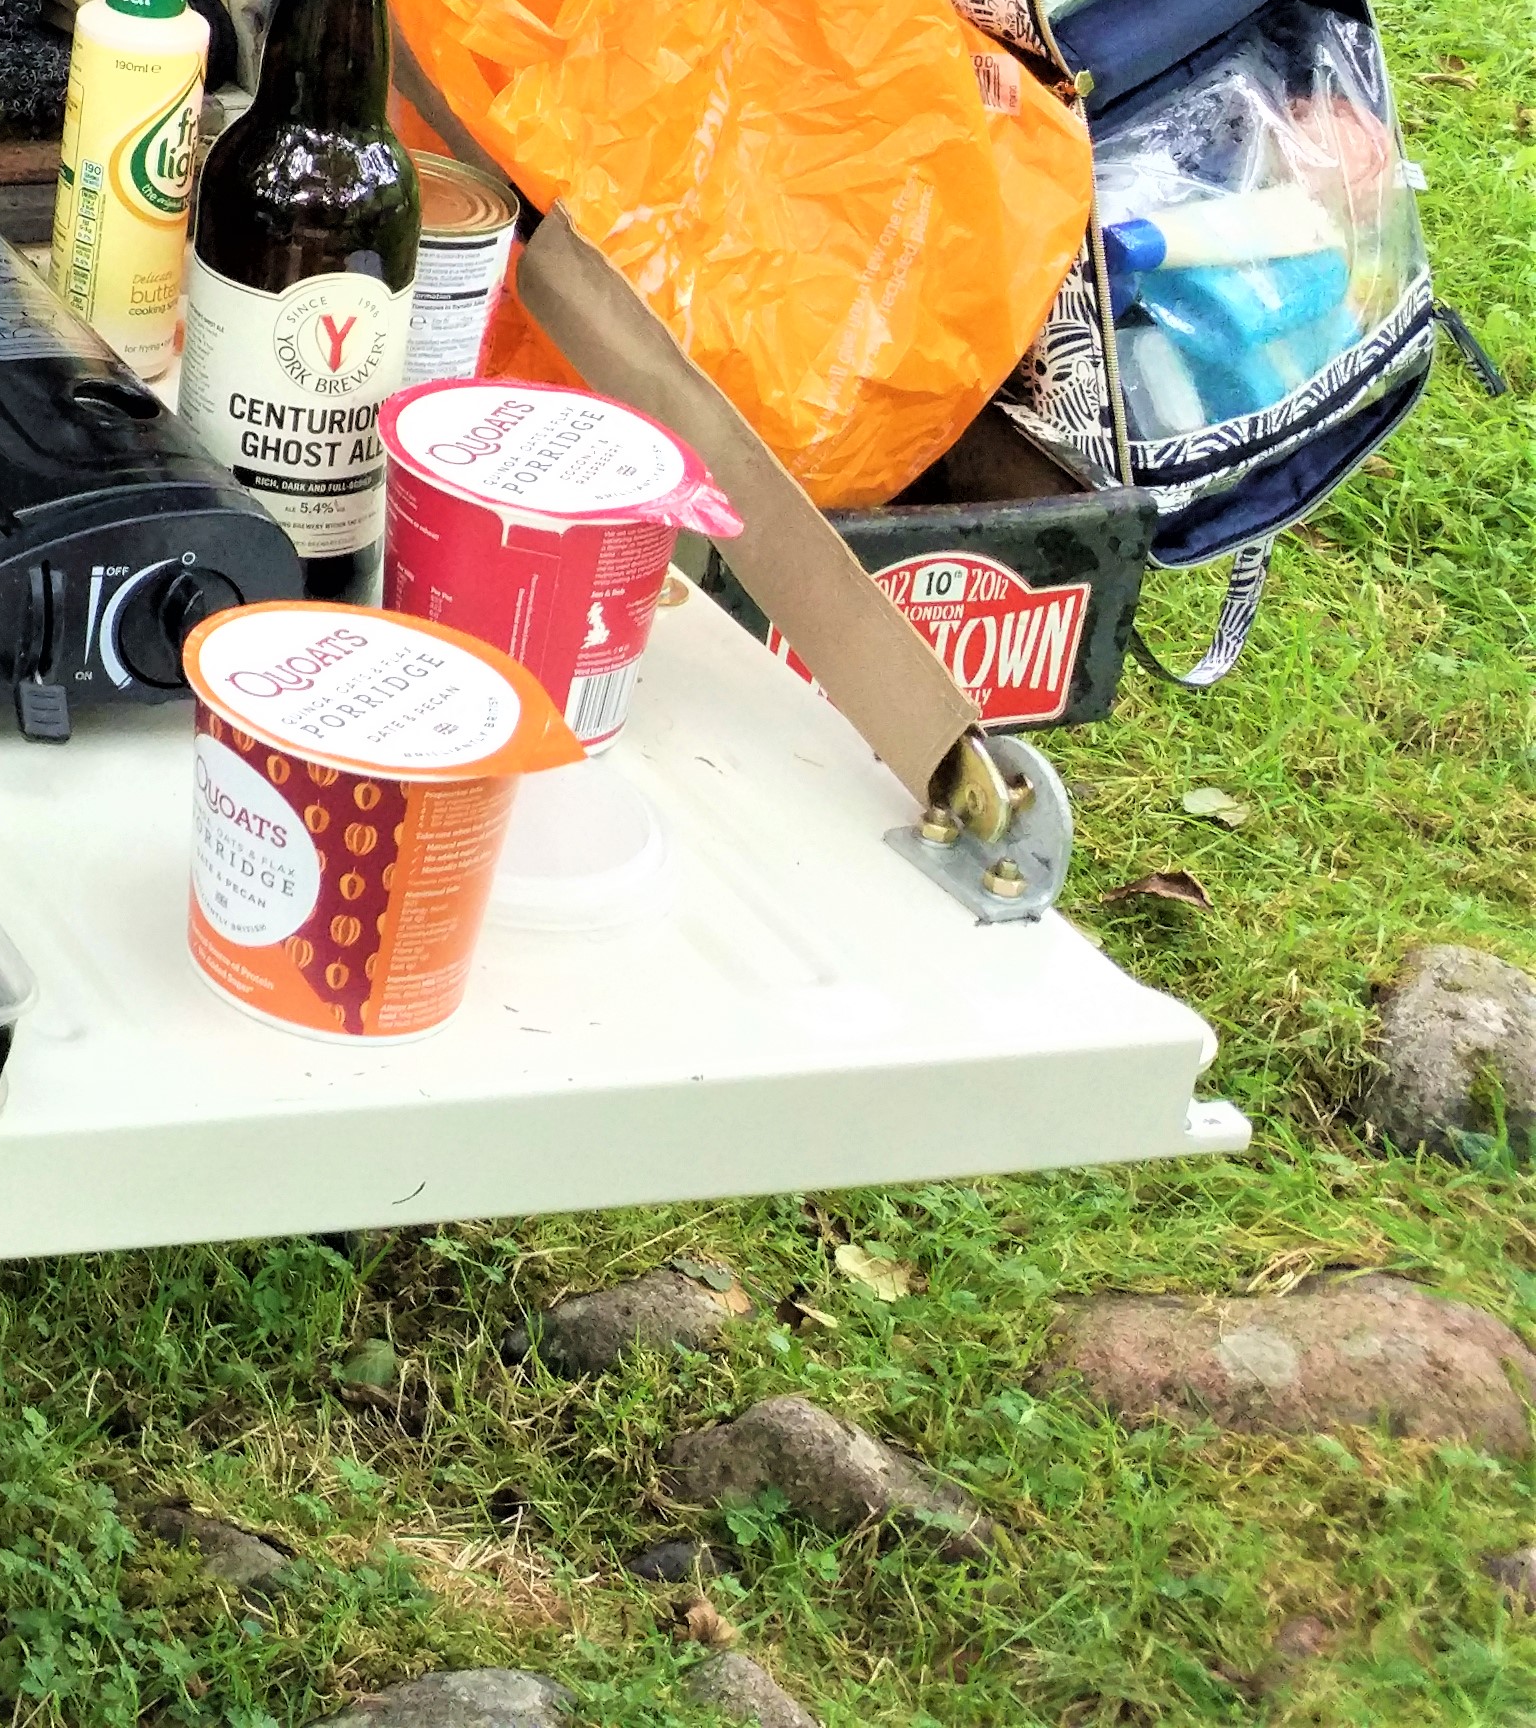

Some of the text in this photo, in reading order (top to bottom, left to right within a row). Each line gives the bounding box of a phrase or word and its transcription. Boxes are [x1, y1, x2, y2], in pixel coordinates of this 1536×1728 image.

[115, 59, 150, 73] 190ml
[84, 162, 102, 176] 190
[879, 210, 902, 247] one
[881, 241, 917, 315] recycled
[128, 302, 167, 316] cooking
[287, 296, 380, 324] SINCE 1996
[277, 334, 313, 386] YORK
[314, 331, 387, 395] BREWERY
[241, 430, 342, 468] GHOST
[425, 400, 536, 465] QUOATS
[483, 454, 520, 486] QUINOA
[501, 409, 605, 495] PORRIDGE
[255, 475, 278, 490] RICH,
[281, 481, 306, 492] DARK
[308, 483, 327, 493] AND
[300, 502, 334, 515] 5.4%
[106, 566, 131, 577] OFF
[966, 568, 1009, 603] 2012
[929, 595, 1077, 693] TOWN
[75, 671, 93, 681] ON
[225, 628, 368, 698] QUOATS
[281, 696, 333, 725] QUINOA
[336, 673, 371, 694] OATS
[380, 646, 412, 668] FLAX
[300, 652, 445, 739] PORRIDGE
[366, 717, 405, 744] DATE
[414, 684, 461, 715] PECAN
[195, 753, 288, 850] QUOATS
[195, 816, 297, 899] ORRIDGE
[260, 854, 297, 879] FLAX
[240, 965, 275, 992] Protein
